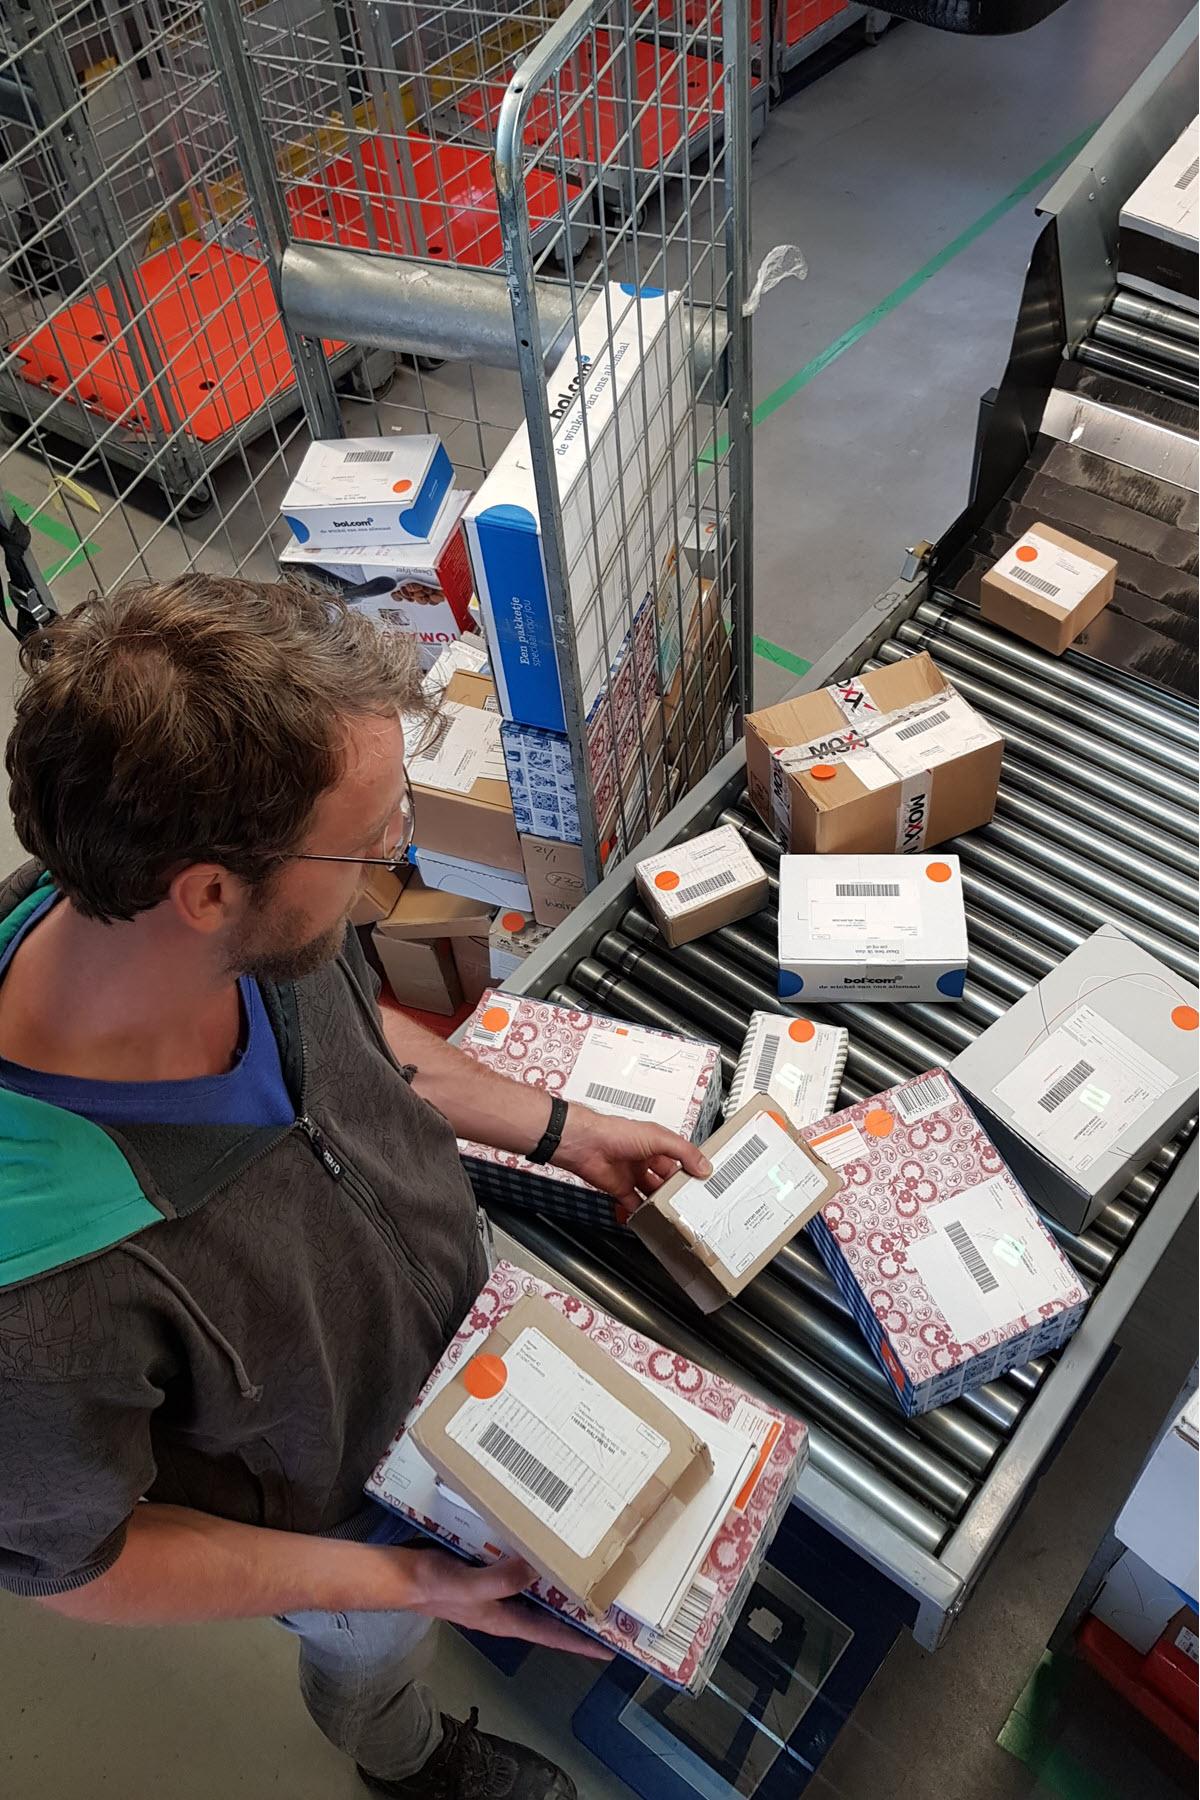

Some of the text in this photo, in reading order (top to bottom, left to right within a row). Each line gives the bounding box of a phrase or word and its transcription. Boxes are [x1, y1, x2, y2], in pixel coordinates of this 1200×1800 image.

[556, 443, 568, 456] de
[586, 391, 598, 410] van
[596, 376, 608, 393] ons
[333, 518, 372, 528] bol.com
[510, 596, 530, 665] Een pakketje
[903, 794, 926, 846] MOXX
